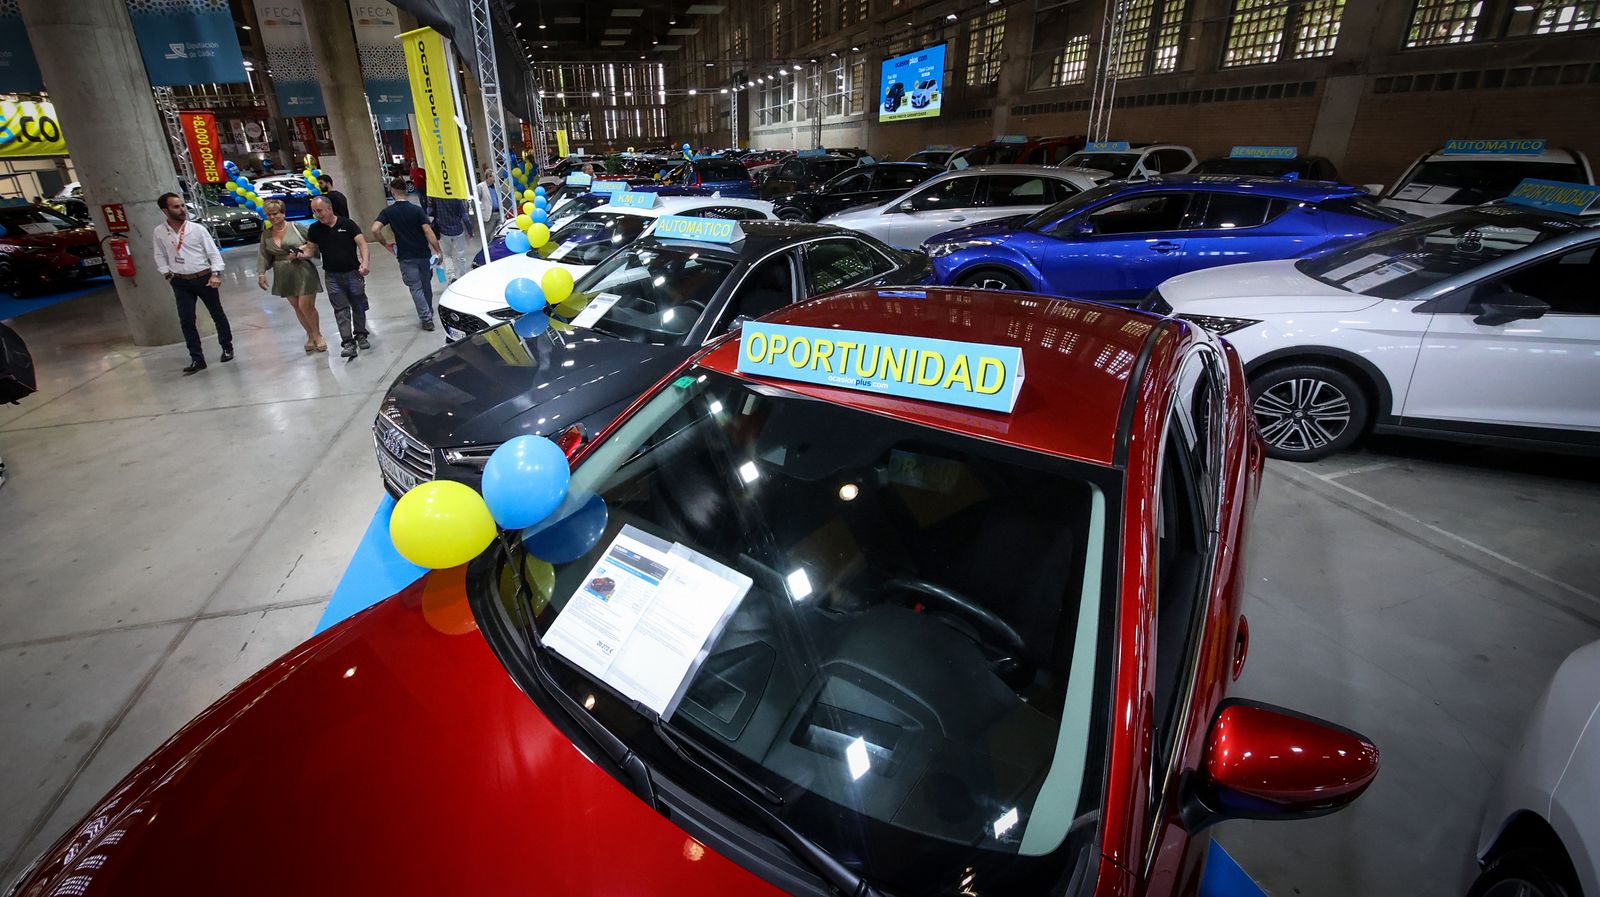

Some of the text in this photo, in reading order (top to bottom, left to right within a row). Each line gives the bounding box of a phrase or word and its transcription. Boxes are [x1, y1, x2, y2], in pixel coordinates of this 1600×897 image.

[260, 7, 300, 18] IFECA
[356, 7, 393, 17] IFECA
[193, 115, 220, 182] +8.000 COCHES
[1447, 141, 1543, 150] AUTOMATICO
[1513, 182, 1597, 207] OPORTUNIDAD
[658, 219, 731, 238] AUTOMATICO
[746, 331, 1006, 395] OPORTUNIDAD
[827, 375, 889, 389] ocasionplus.com
